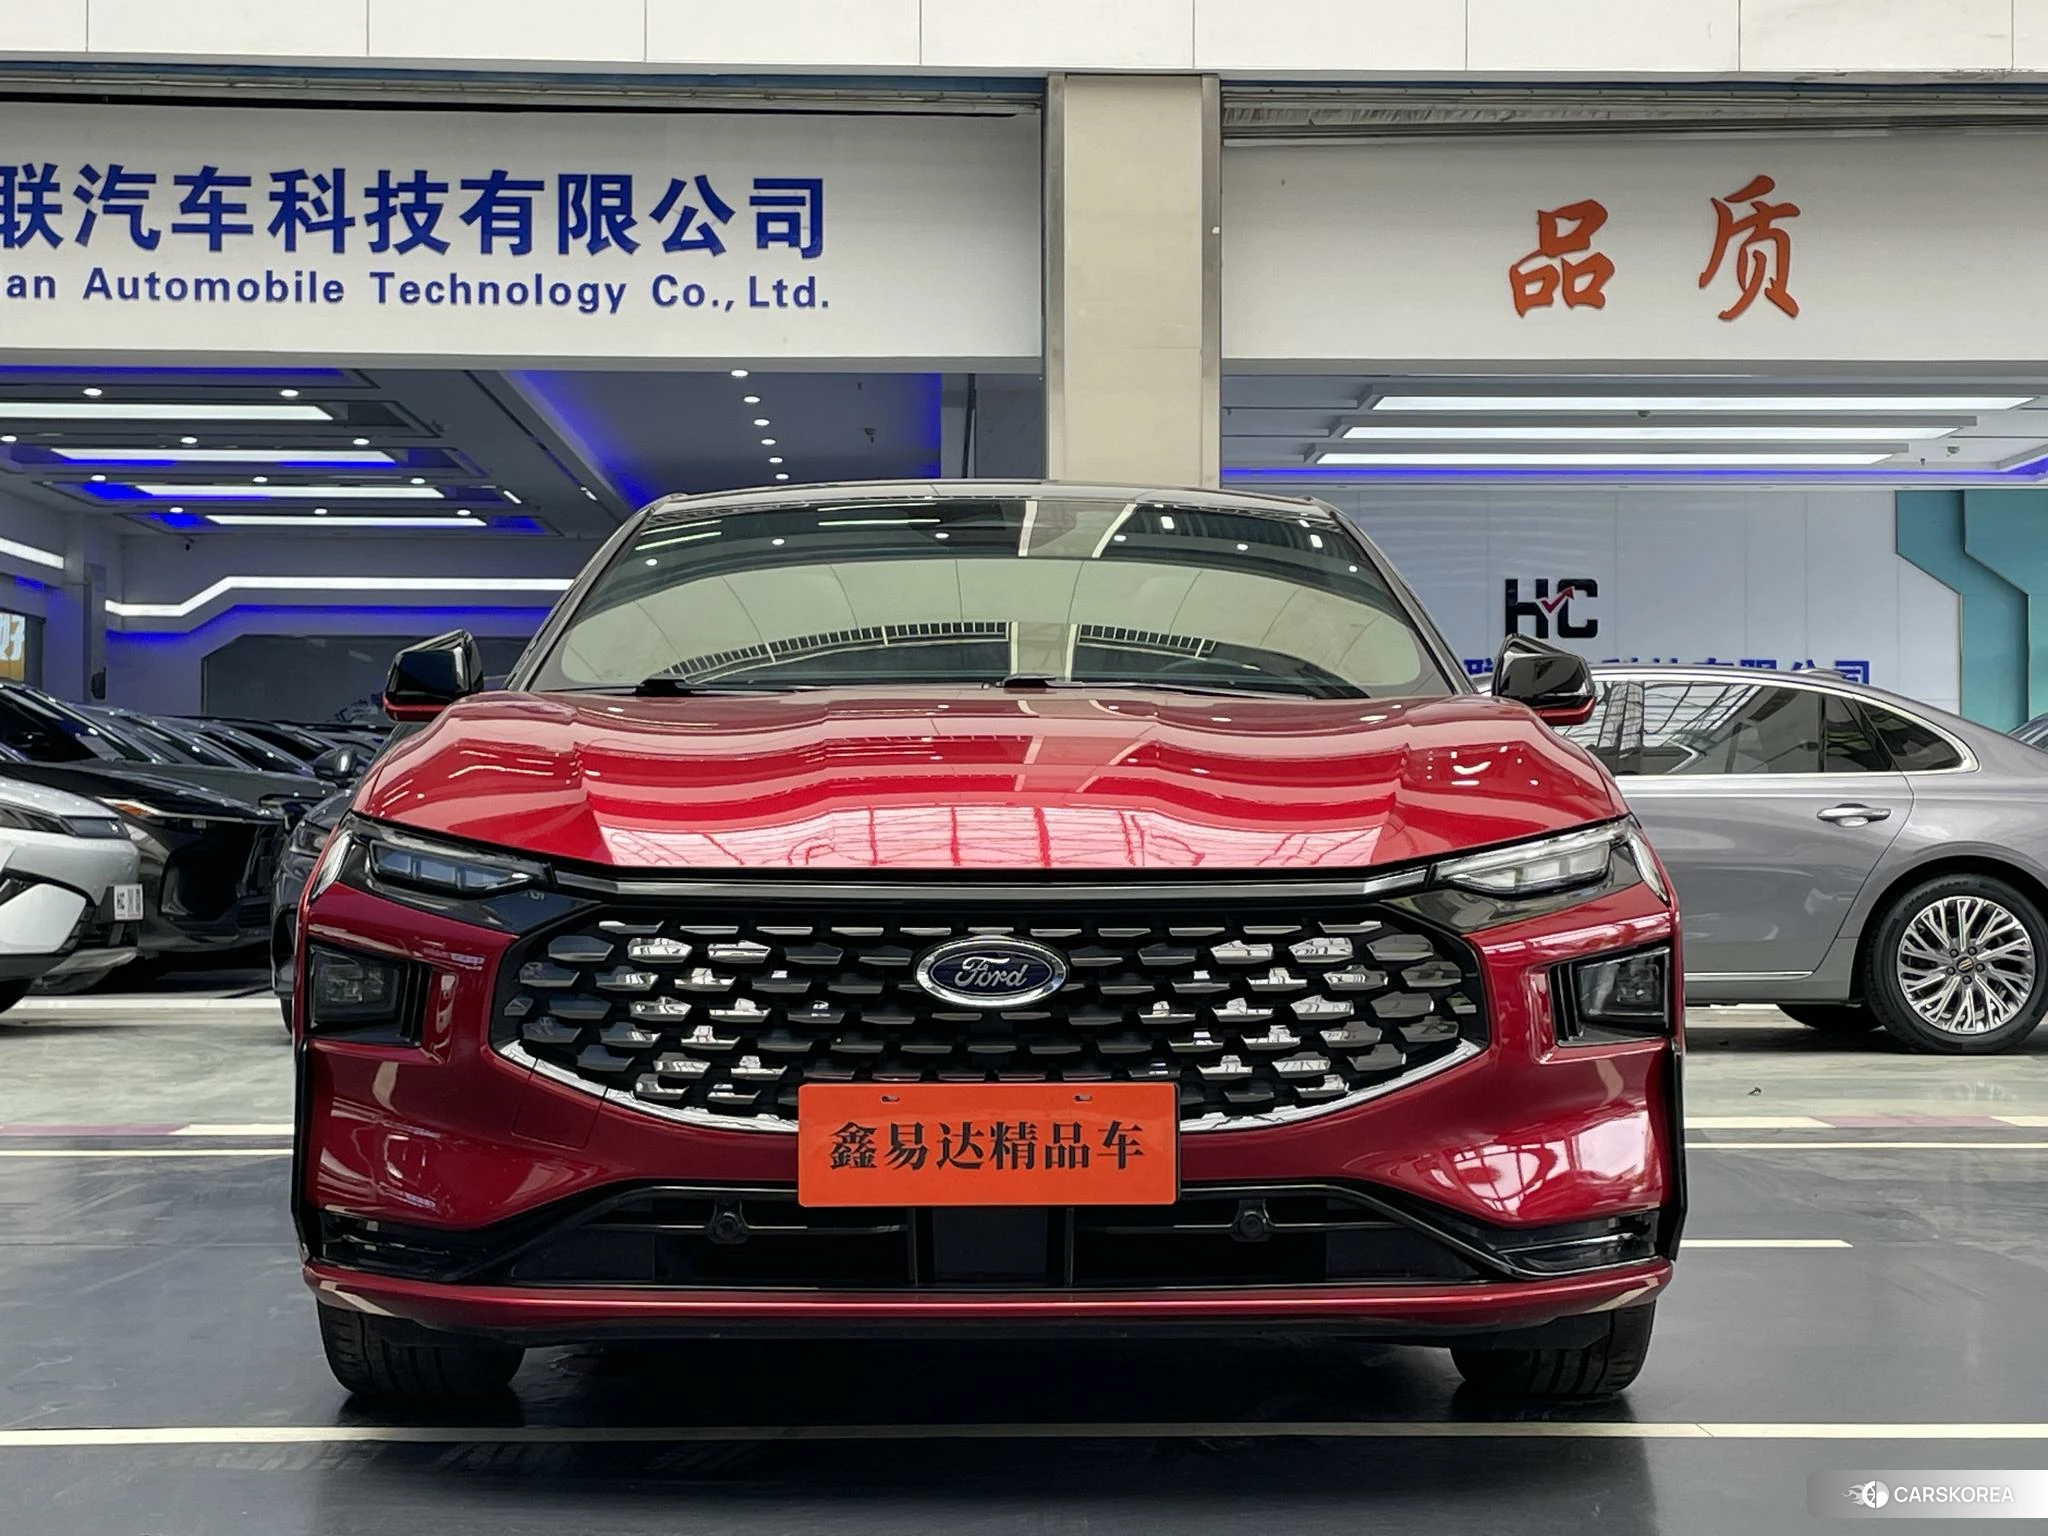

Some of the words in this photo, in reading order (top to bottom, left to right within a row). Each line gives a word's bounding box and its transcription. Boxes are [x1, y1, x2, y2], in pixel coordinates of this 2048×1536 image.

[0, 163, 825, 259] 联汽车科技有限公司
[1509, 174, 1801, 322] 品质
[6, 274, 57, 299] an
[82, 266, 345, 304] Automobile
[370, 271, 628, 314] Technology
[748, 277, 831, 309] Ltd.
[953, 956, 1028, 988] Ford
[828, 1120, 1146, 1171] 鑫易达精品车
